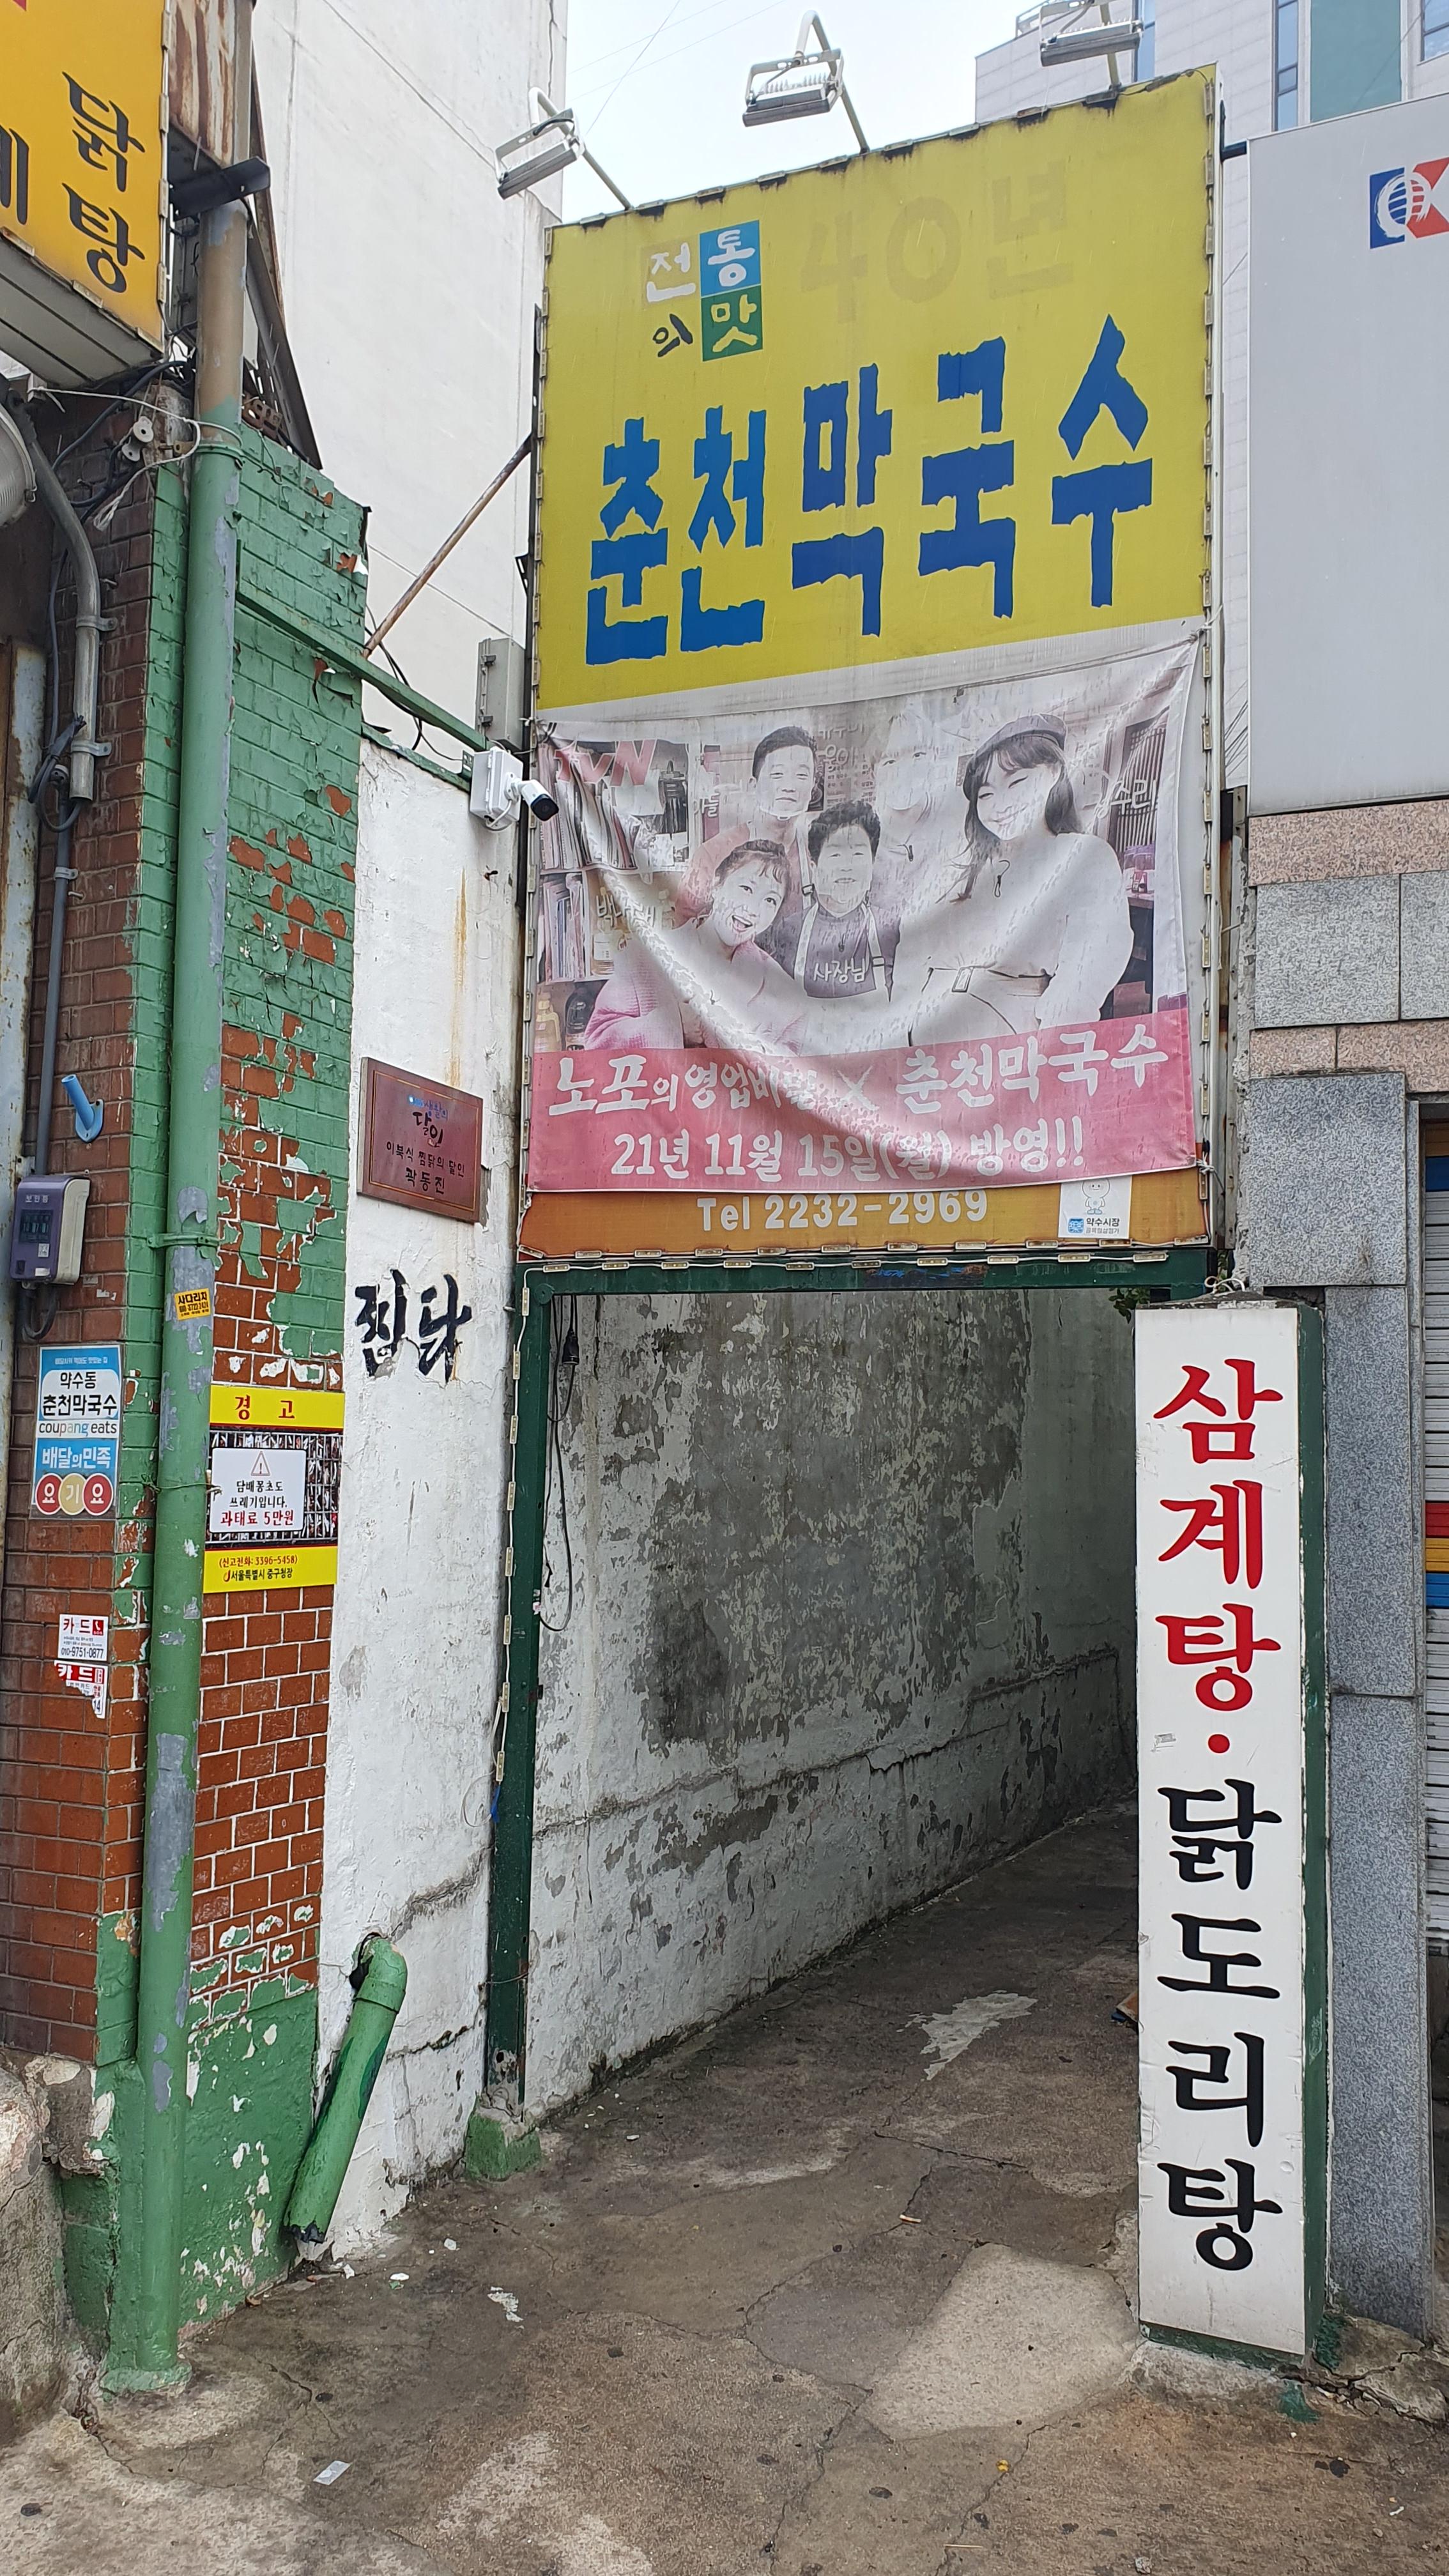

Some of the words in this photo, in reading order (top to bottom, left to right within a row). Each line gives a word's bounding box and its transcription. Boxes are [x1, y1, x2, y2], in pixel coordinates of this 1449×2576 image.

[585, 313, 1153, 666] 춘천막국수
[813, 957, 866, 984] 사장님
[896, 1023, 1169, 1114] 춘천막국수
[611, 1128, 689, 1179] 21년
[704, 1129, 783, 1182] 11월
[970, 1115, 1085, 1176] 방영!!
[418, 1151, 444, 1170] 찜닭의
[448, 1160, 465, 1178] 달인
[697, 1197, 751, 1232] Tel
[765, 1190, 988, 1229] 2232-2969
[1086, 1218, 1120, 1227] 약수시장
[60, 1371, 96, 1390] 약수동
[43, 1394, 117, 1416] 춘천막국수
[39, 1422, 89, 1437] coupang
[91, 1420, 118, 1434] eats
[42, 1446, 111, 1469] 배달의민족
[42, 1483, 104, 1504] 요기요
[236, 1480, 284, 1494] 담배꽁초도
[229, 1496, 288, 1508] 쓰레기입니다.
[220, 1510, 258, 1527] 과태료
[263, 1509, 295, 1526] 5만원
[255, 1554, 298, 1565] 3396-5458)
[231, 1568, 265, 1581] 서울특별시
[266, 1567, 293, 1579] 중구청장
[61, 1646, 104, 1659] 010-9751-0877
